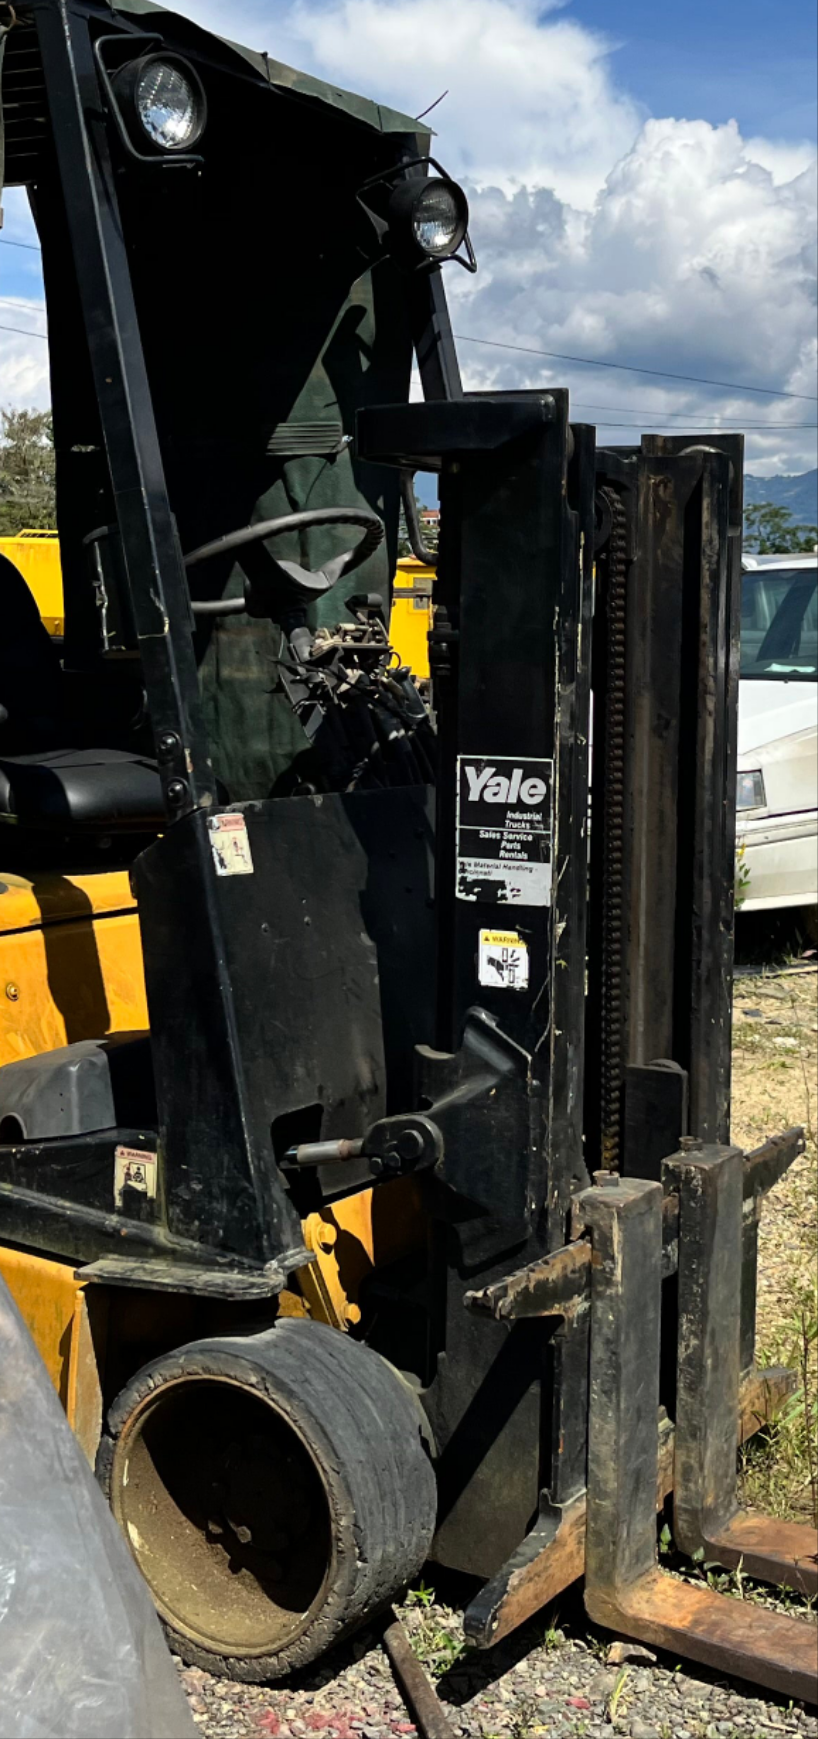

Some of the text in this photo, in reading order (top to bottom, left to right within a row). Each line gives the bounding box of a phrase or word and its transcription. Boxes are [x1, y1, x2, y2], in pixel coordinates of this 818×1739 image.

[464, 766, 547, 805] Yale
[506, 811, 543, 821] Industrial
[505, 819, 531, 830] Trucks
[479, 830, 533, 842] Sales Service
[501, 841, 521, 851] Parts
[499, 850, 528, 861] Rentals
